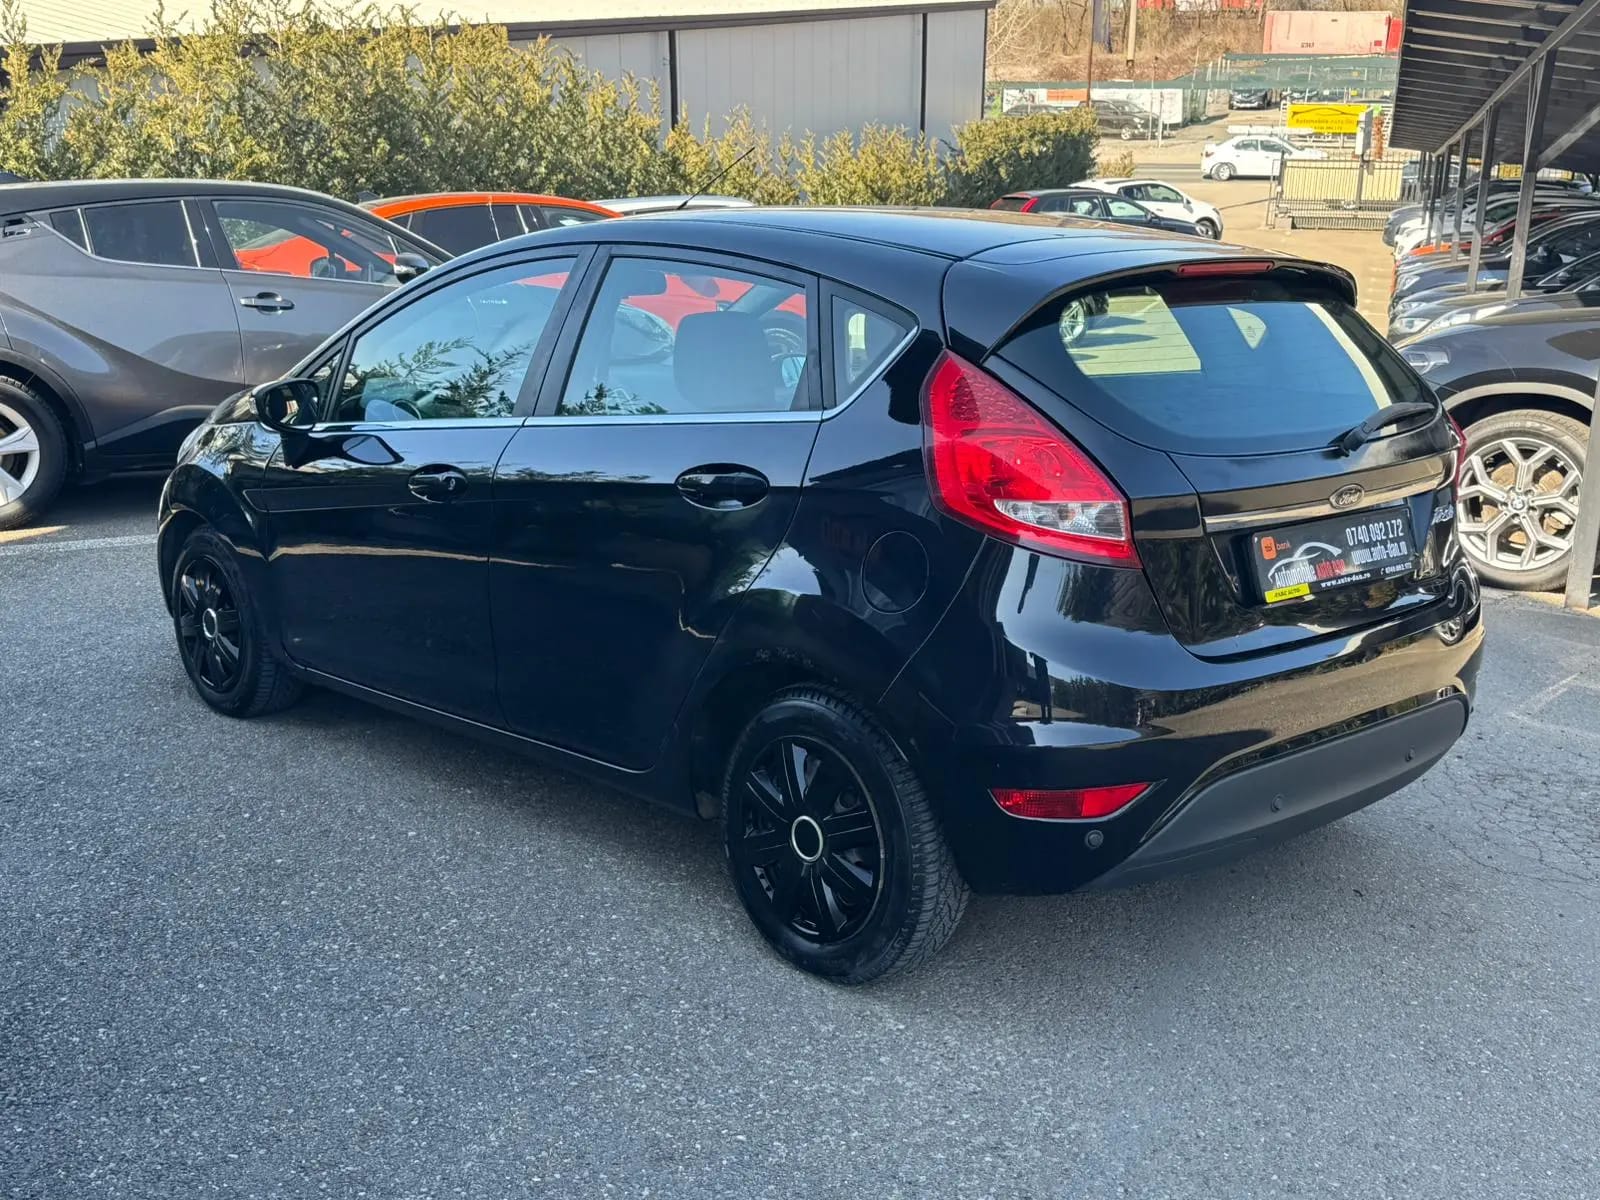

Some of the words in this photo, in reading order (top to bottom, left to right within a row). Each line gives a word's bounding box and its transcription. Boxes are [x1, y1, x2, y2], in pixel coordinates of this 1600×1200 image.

[1339, 489, 1360, 505] Ford
[1345, 525, 1370, 546] 0740
[1369, 522, 1387, 542] 092
[1386, 519, 1405, 539] 172
